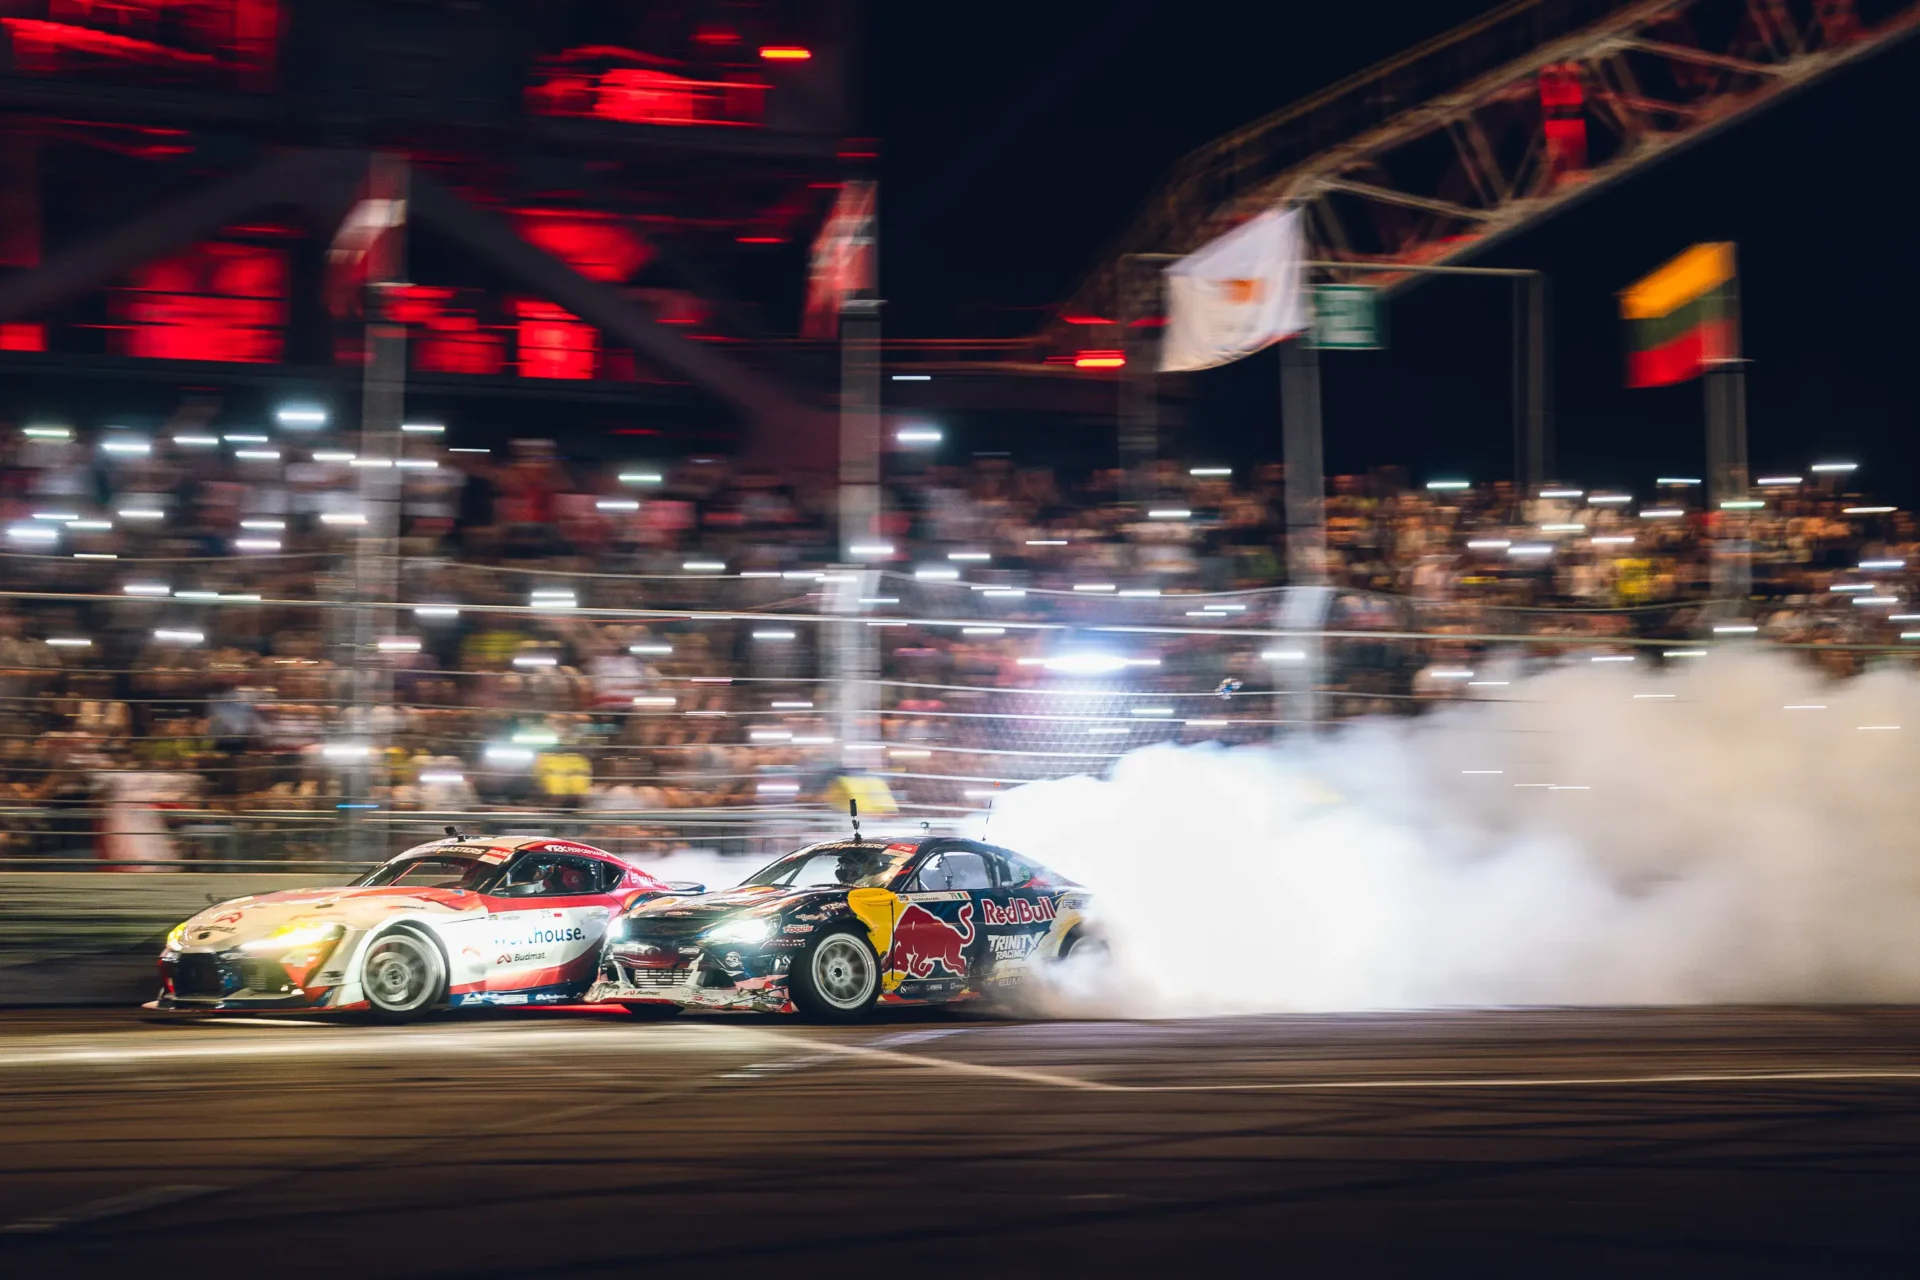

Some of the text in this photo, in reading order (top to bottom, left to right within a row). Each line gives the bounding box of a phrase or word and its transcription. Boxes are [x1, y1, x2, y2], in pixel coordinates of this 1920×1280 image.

[981, 896, 1056, 925] Red Bull
[494, 927, 586, 945] house.
[987, 931, 1046, 952] TRINITY
[995, 949, 1026, 960] RACING
